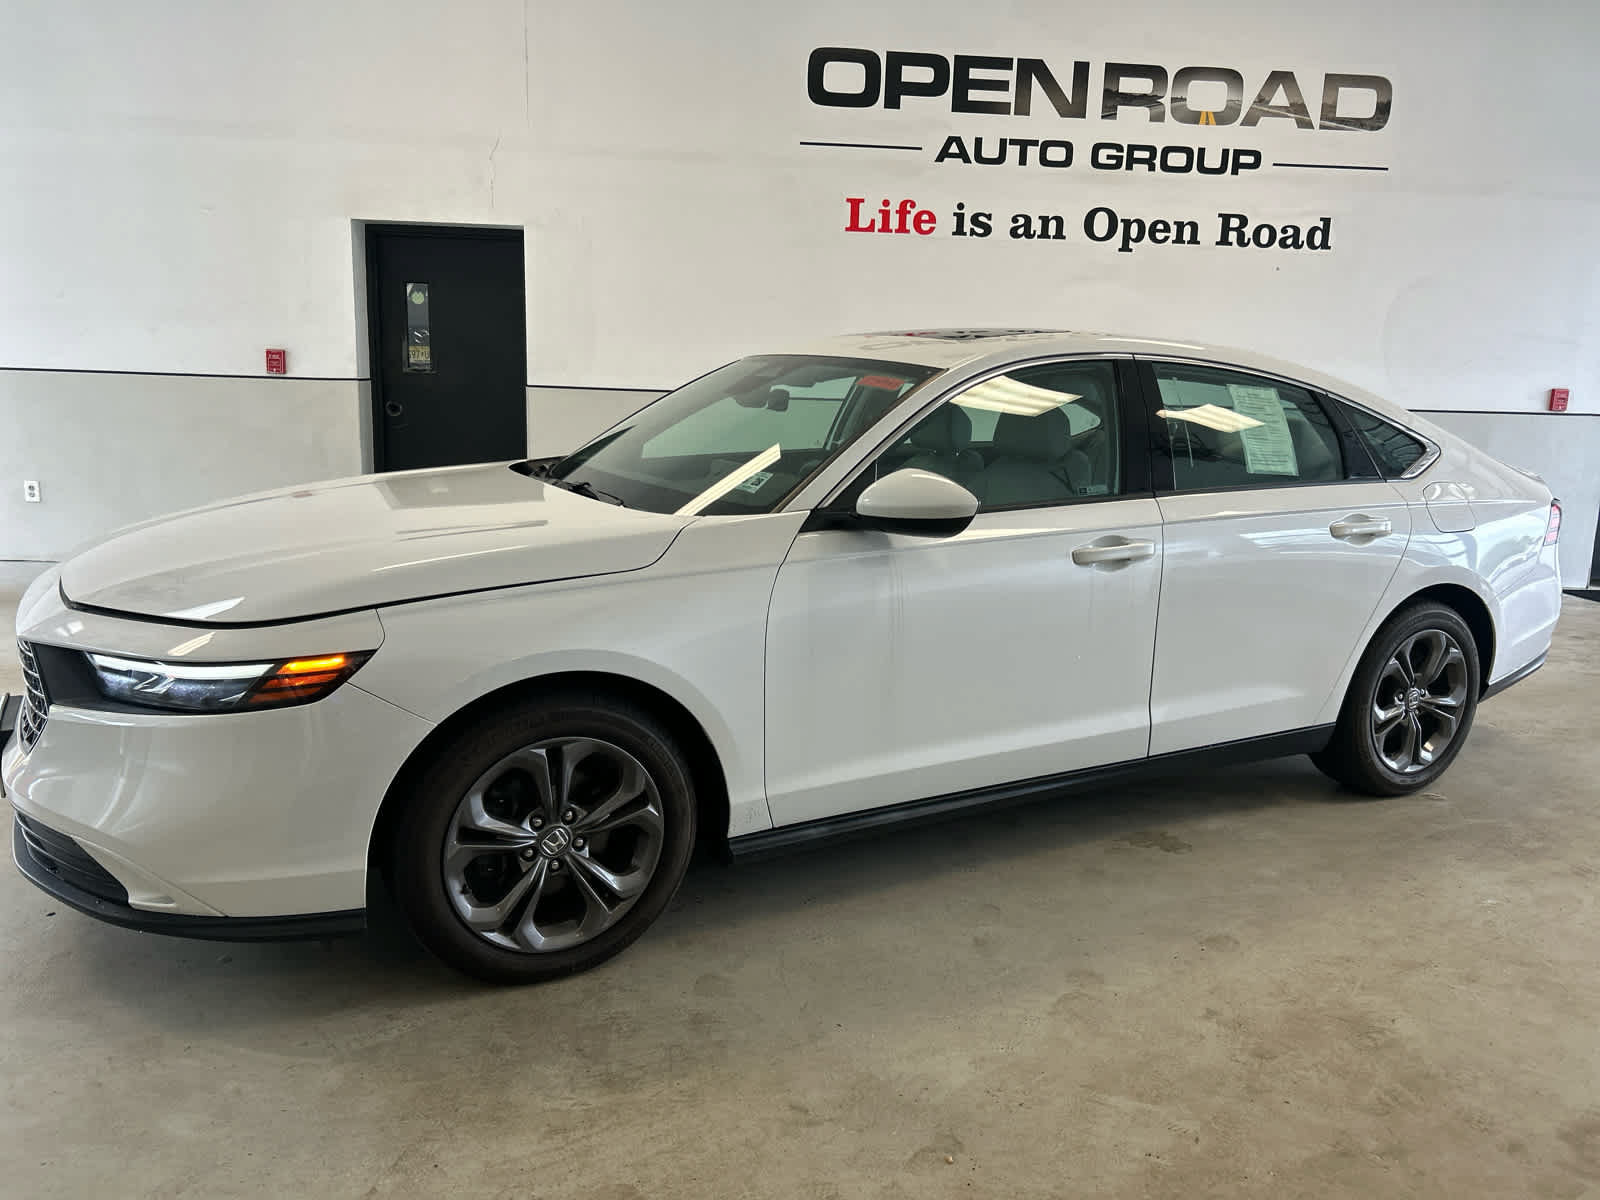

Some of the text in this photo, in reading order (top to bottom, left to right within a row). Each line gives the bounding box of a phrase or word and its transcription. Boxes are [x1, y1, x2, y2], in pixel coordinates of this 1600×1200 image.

[807, 47, 1393, 132] OPEN ROAD
[934, 135, 1262, 176] AUTO GROUP
[845, 197, 1332, 253] Life is an Open Road
